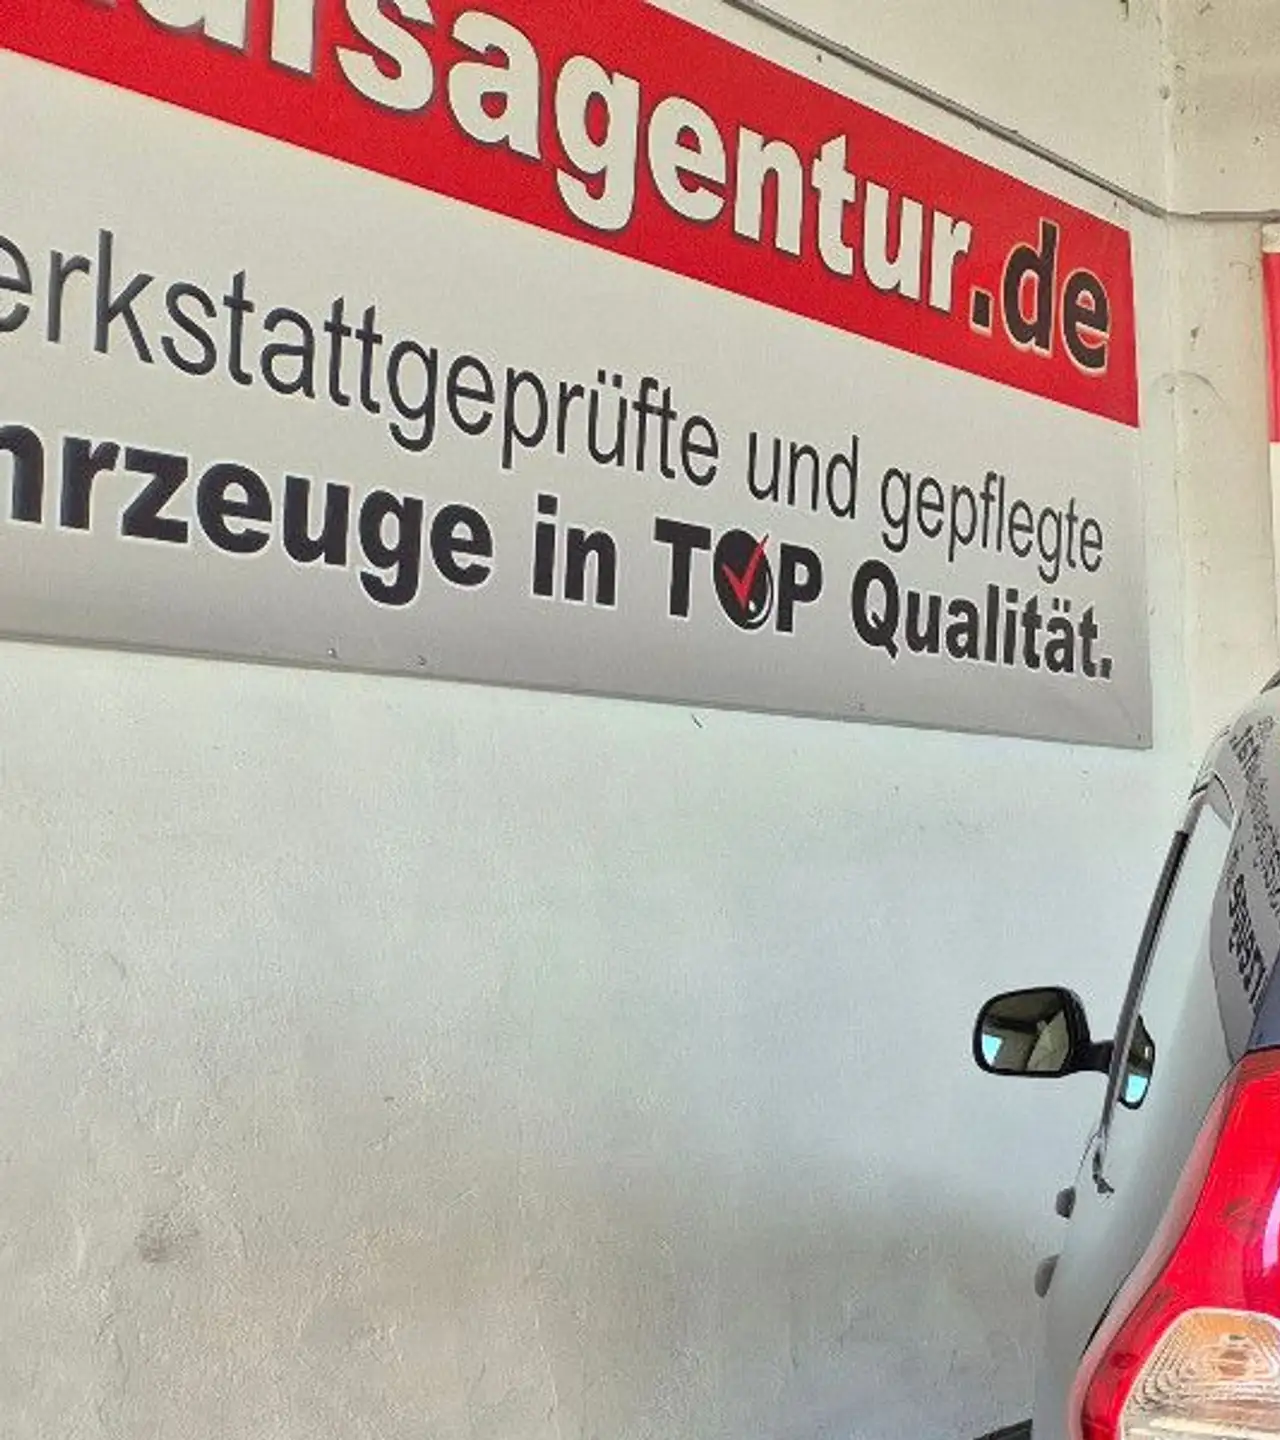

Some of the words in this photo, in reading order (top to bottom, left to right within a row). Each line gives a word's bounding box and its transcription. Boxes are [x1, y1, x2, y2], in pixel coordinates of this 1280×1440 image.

[532, 496, 616, 605] in
[653, 518, 823, 633] TOP
[850, 559, 1113, 678] Qualität.
[747, 433, 859, 520] und
[881, 468, 1104, 584] gepflegte
